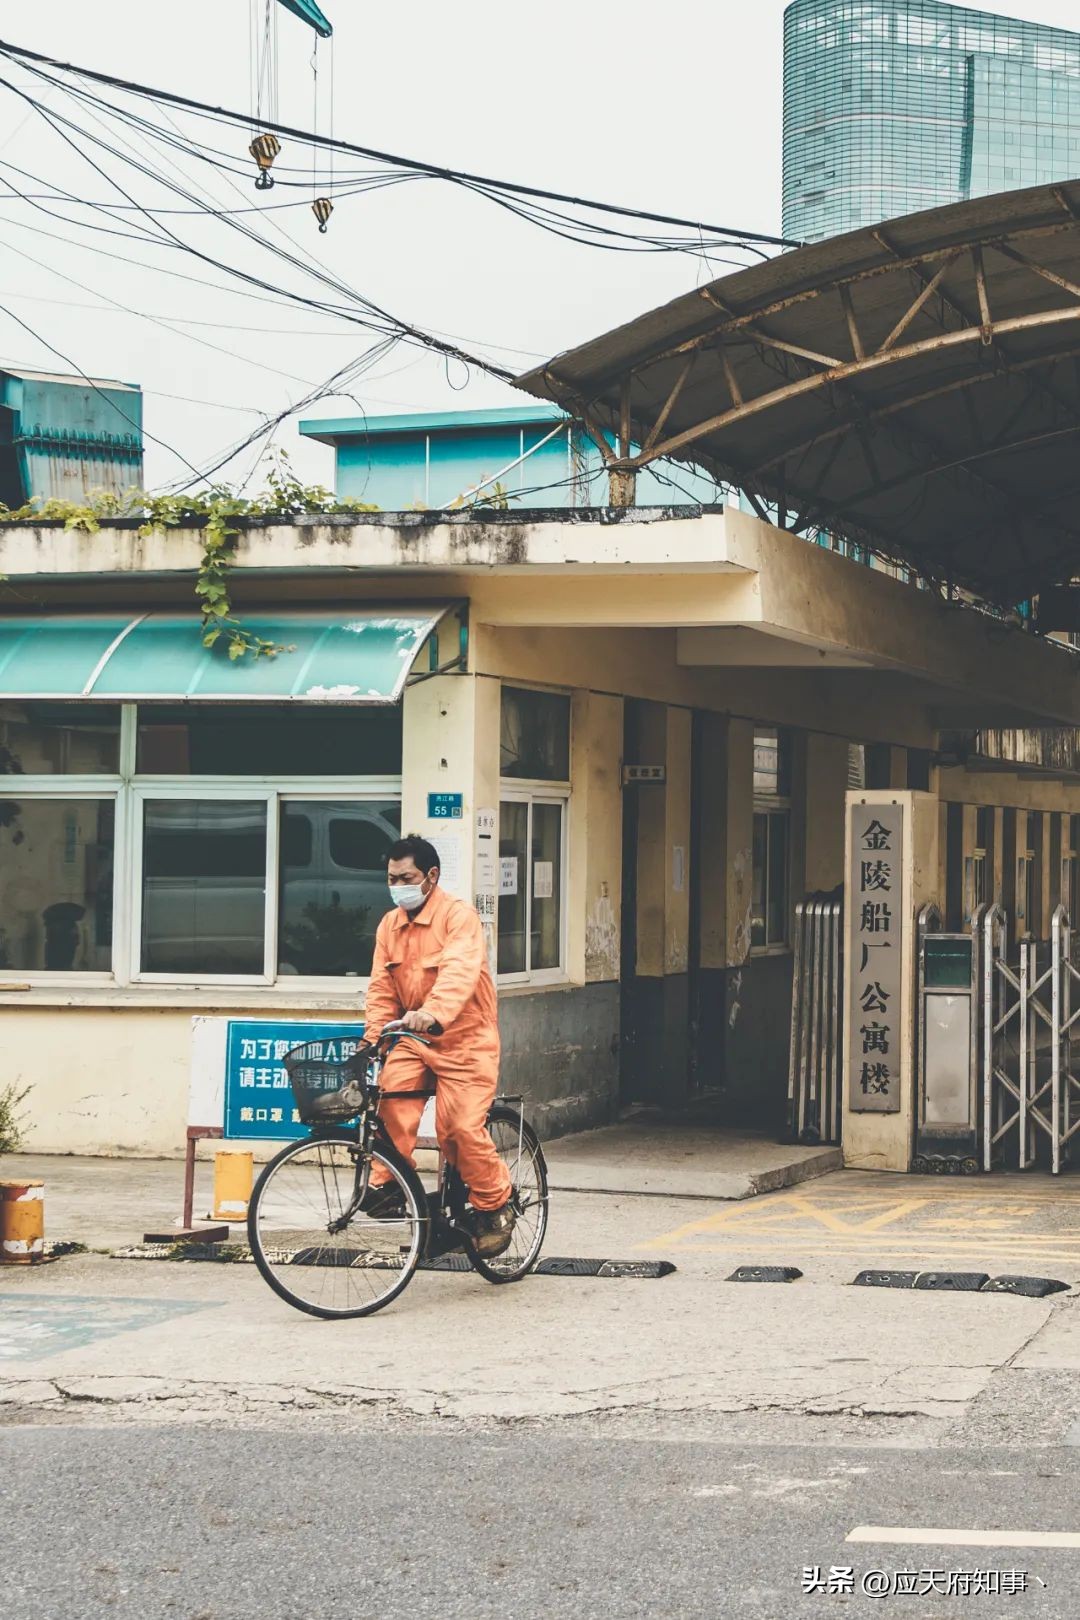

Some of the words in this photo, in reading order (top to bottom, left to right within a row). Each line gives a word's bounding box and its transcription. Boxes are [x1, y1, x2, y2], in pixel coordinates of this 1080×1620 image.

[434, 806, 447, 816] 55
[859, 819, 892, 1096] 金陵船厂公寓楼
